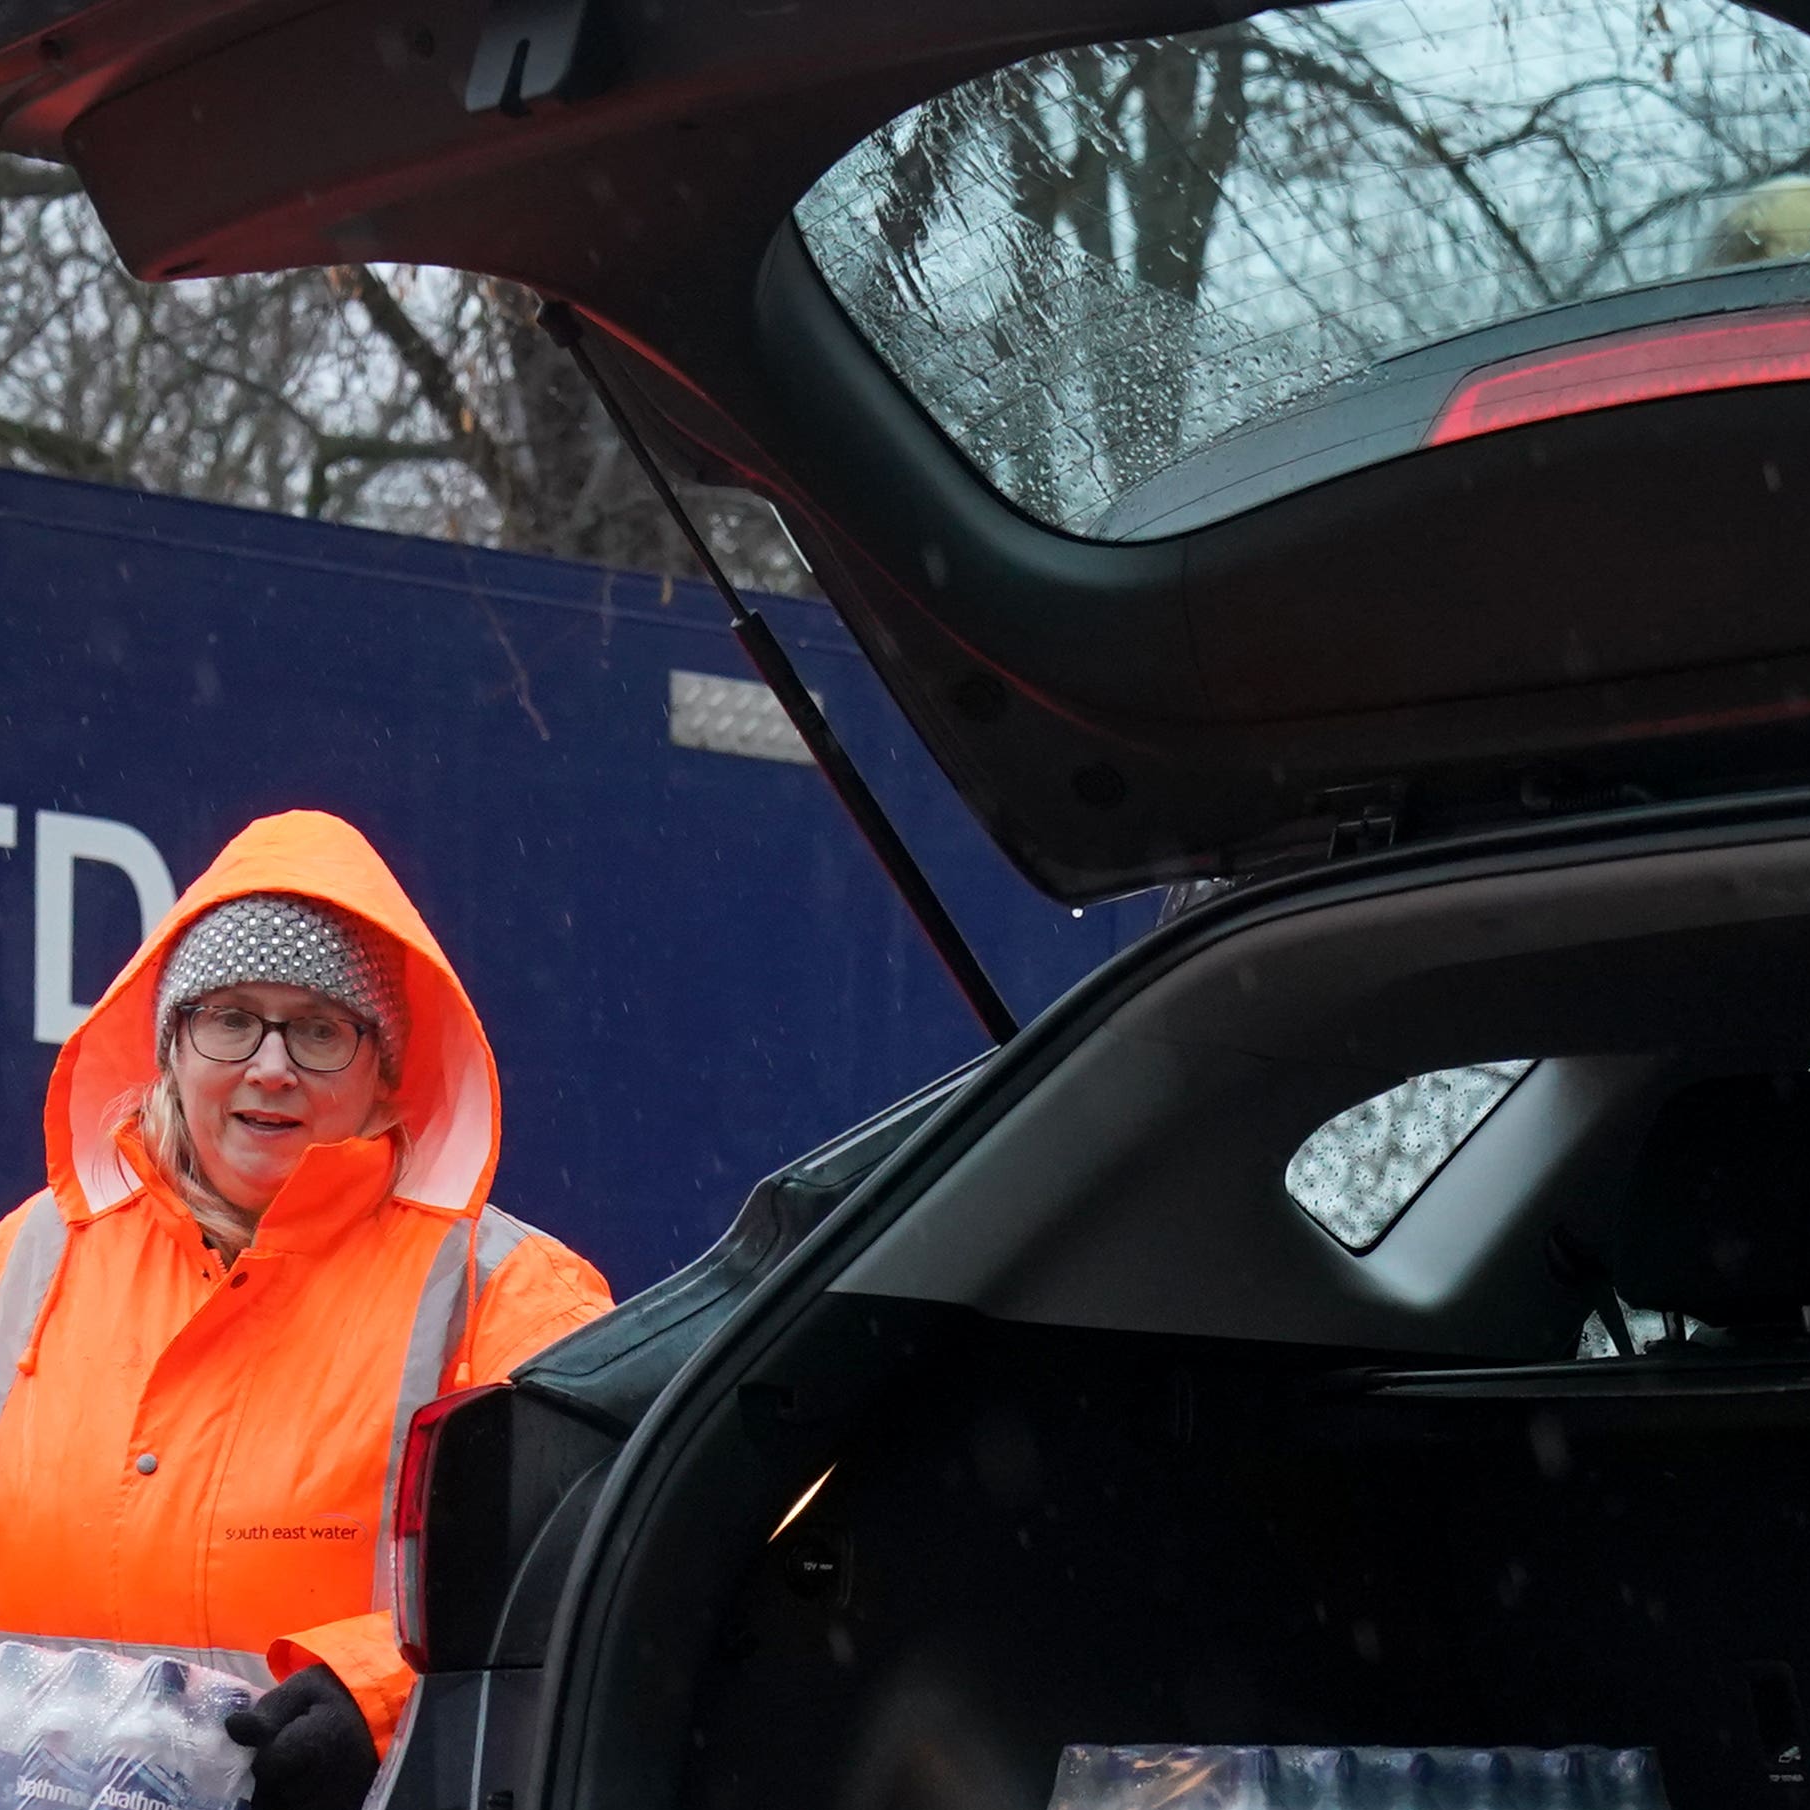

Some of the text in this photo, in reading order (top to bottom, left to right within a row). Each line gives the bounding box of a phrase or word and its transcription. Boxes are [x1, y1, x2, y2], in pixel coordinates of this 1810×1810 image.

[225, 1525, 358, 1541] south east water
